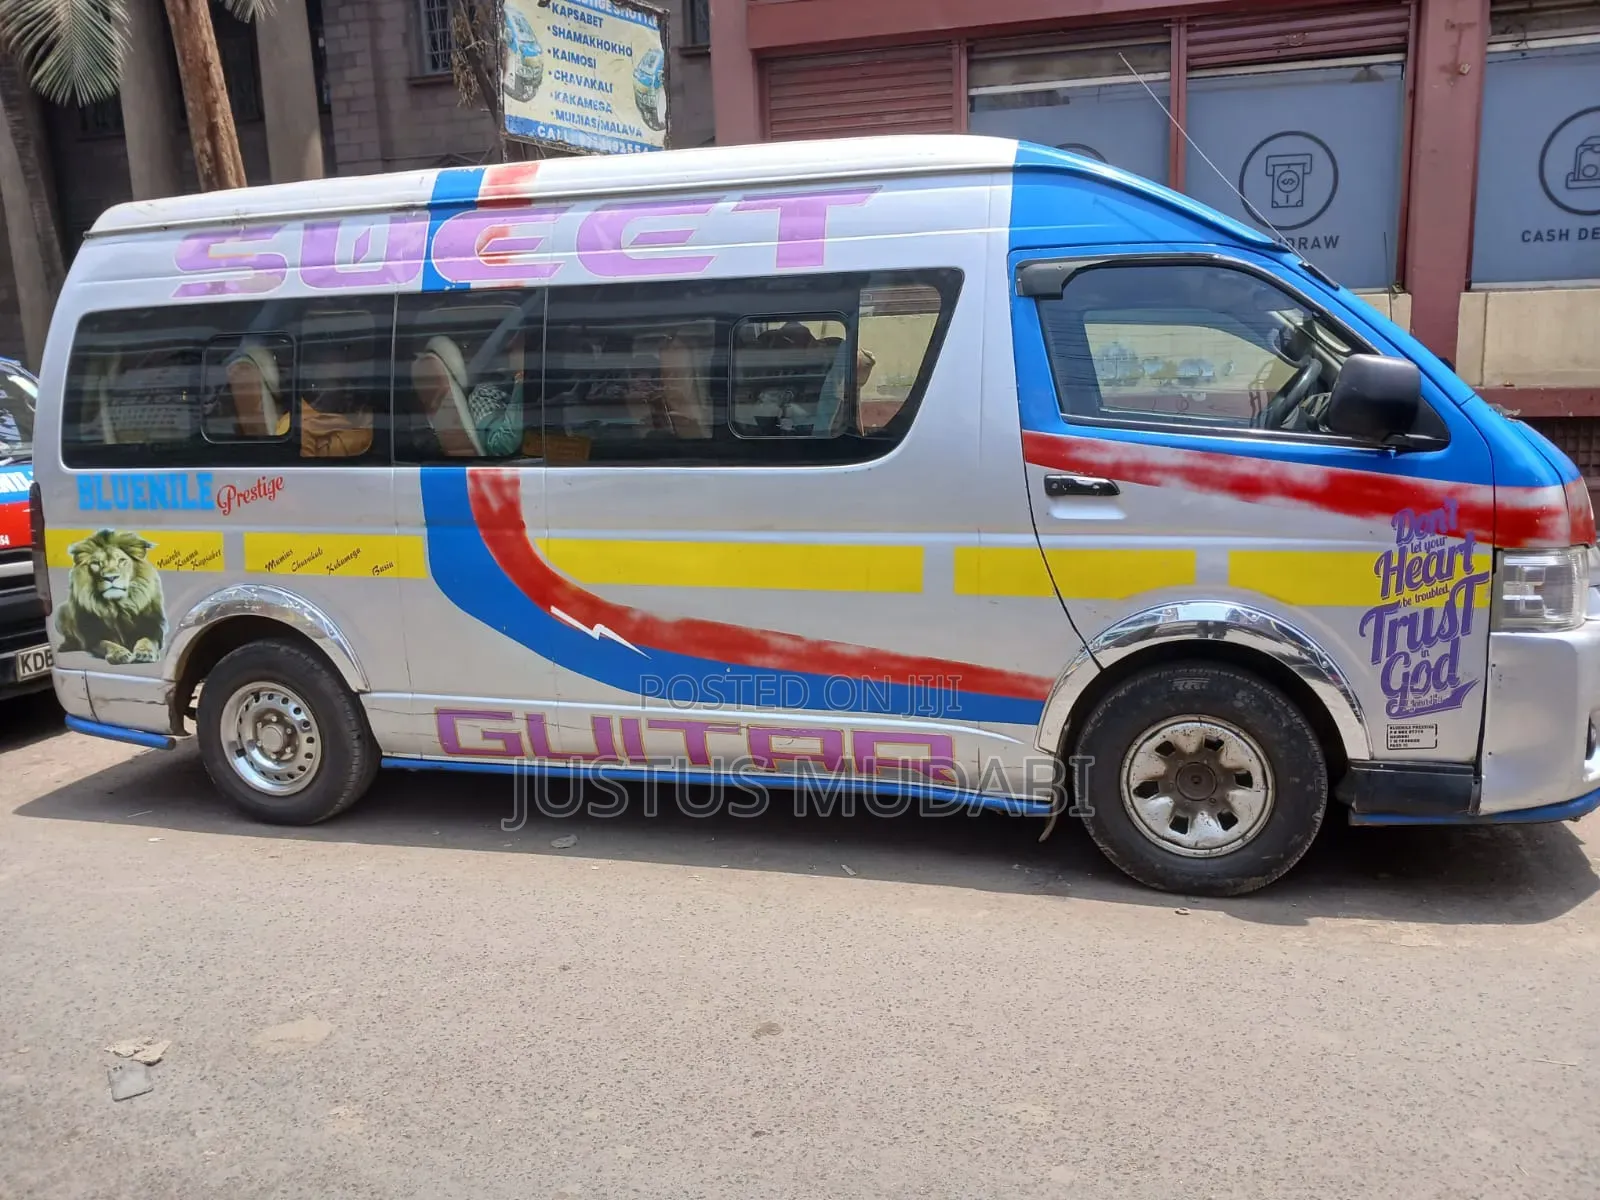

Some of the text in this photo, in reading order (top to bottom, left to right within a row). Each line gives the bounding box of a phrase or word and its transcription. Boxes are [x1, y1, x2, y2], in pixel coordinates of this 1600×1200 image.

[551, 2, 604, 29] KAPSABET
[551, 25, 633, 58] SHAMAKHOKHO
[552, 47, 597, 69] KAIMOSI
[553, 70, 613, 95] CHAVAKALI
[554, 91, 613, 114] KAKAMEGA
[537, 125, 569, 143] CALL
[170, 185, 884, 299] SWEET
[1521, 228, 1570, 243] CASH
[76, 472, 215, 511] BLUENILE
[216, 475, 285, 517] Prestige
[1391, 498, 1460, 547] Don't
[1424, 537, 1448, 553] your
[1374, 531, 1477, 600] Heart
[1380, 636, 1461, 713] God
[435, 706, 957, 784] GUITAR
